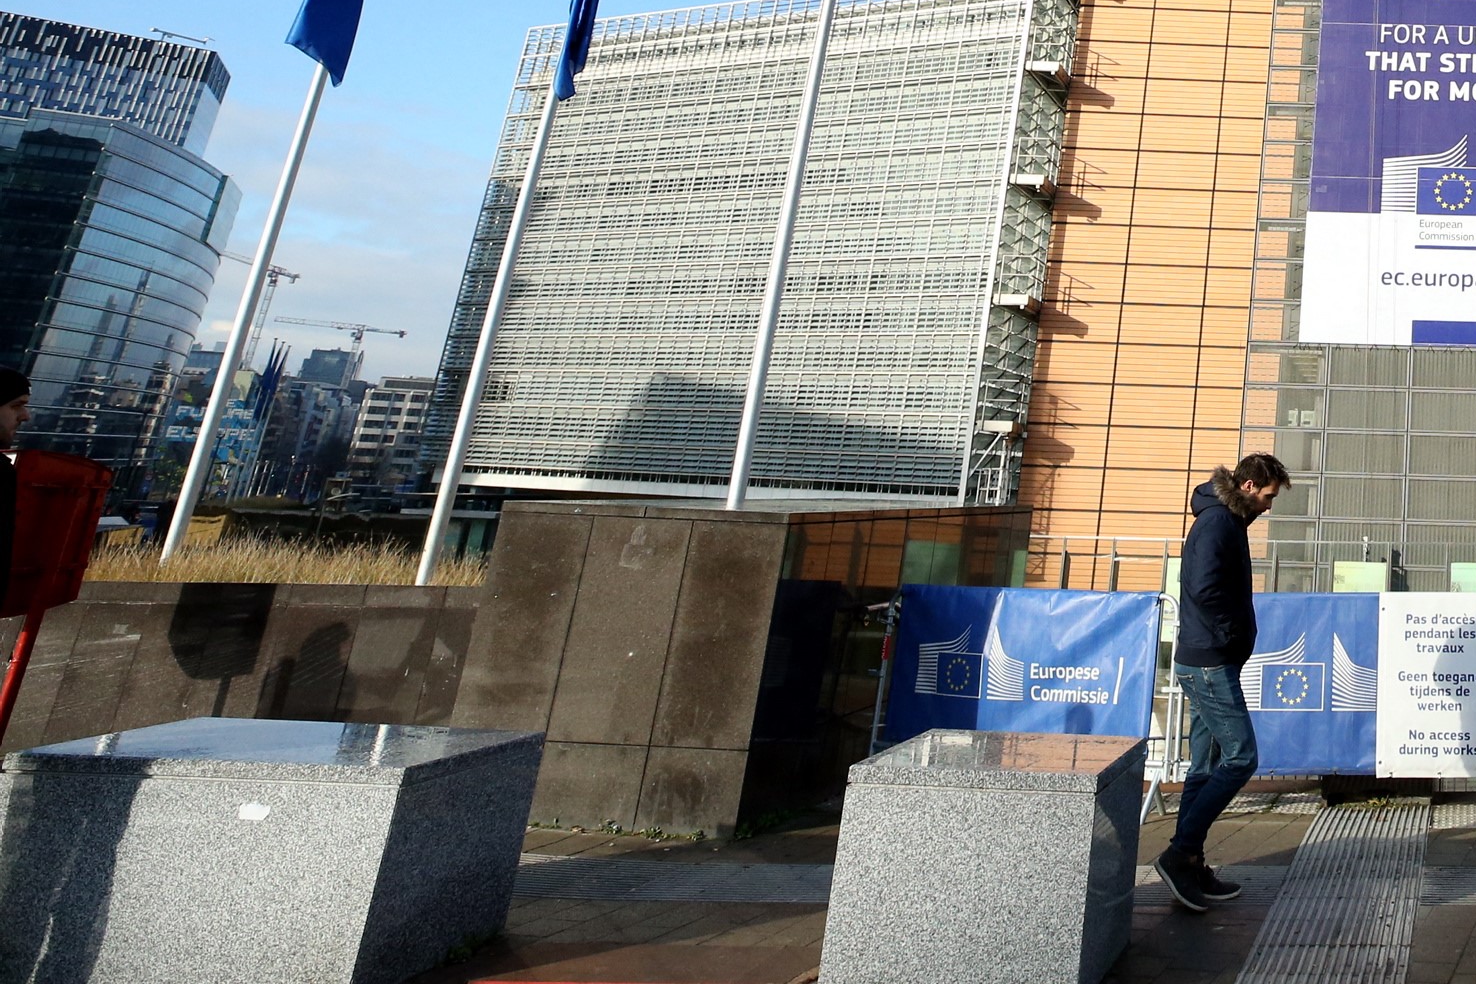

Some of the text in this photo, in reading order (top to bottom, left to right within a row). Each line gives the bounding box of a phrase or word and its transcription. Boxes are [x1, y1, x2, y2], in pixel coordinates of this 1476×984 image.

[1380, 23, 1426, 45] FOR
[1433, 25, 1450, 45] A
[1365, 50, 1432, 72] THAT
[1388, 79, 1440, 101] FOR
[1418, 219, 1464, 230] European
[1418, 231, 1476, 242] Commission
[1406, 614, 1427, 625] Pas
[1404, 628, 1476, 641] pendant les
[1416, 643, 1465, 654] travaux
[1030, 662, 1100, 683] Europese
[1398, 671, 1428, 682] Geen
[1030, 685, 1109, 705] Commissie
[1410, 685, 1470, 699] tijdens de
[1417, 700, 1463, 712] werken
[1408, 729, 1471, 741] No access
[1399, 744, 1439, 758] during
